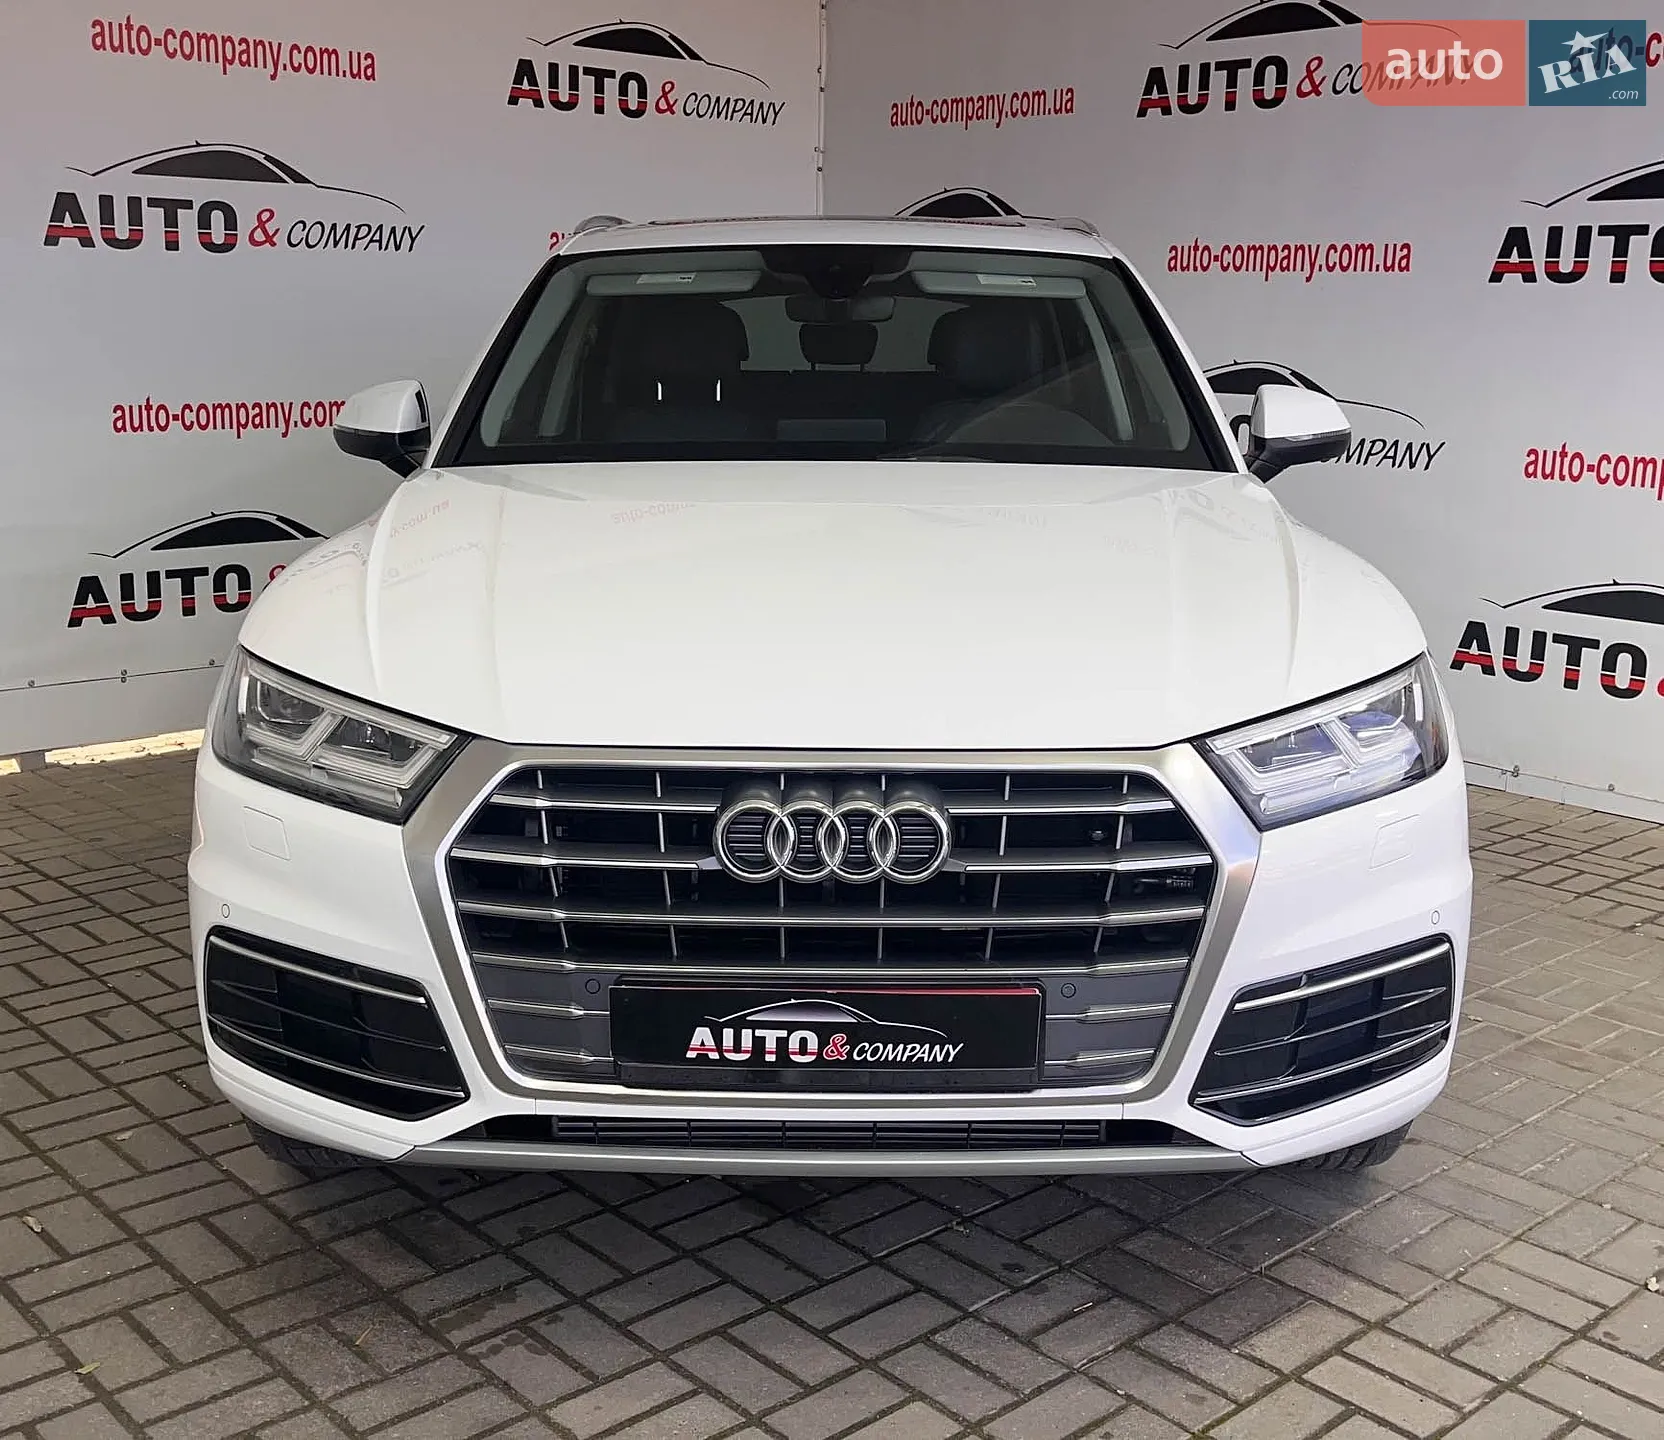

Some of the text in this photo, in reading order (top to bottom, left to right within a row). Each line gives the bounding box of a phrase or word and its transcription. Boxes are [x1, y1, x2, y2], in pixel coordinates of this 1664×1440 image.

[91, 15, 377, 82] auto-company.com.ua
[506, 57, 785, 127] AUTO & COMPANY
[890, 86, 1075, 131] auto-company.com.ua
[1135, 55, 1289, 119] AUTO
[1295, 55, 1327, 99] &
[43, 191, 425, 254] AUTO & COMPANY
[1487, 223, 1664, 284] AUT
[1167, 238, 1412, 283] auto-company.com.ua
[67, 563, 252, 629] AUTO
[1449, 620, 1648, 700] AUTO
[685, 1026, 965, 1064] AUTO & COMPANY
